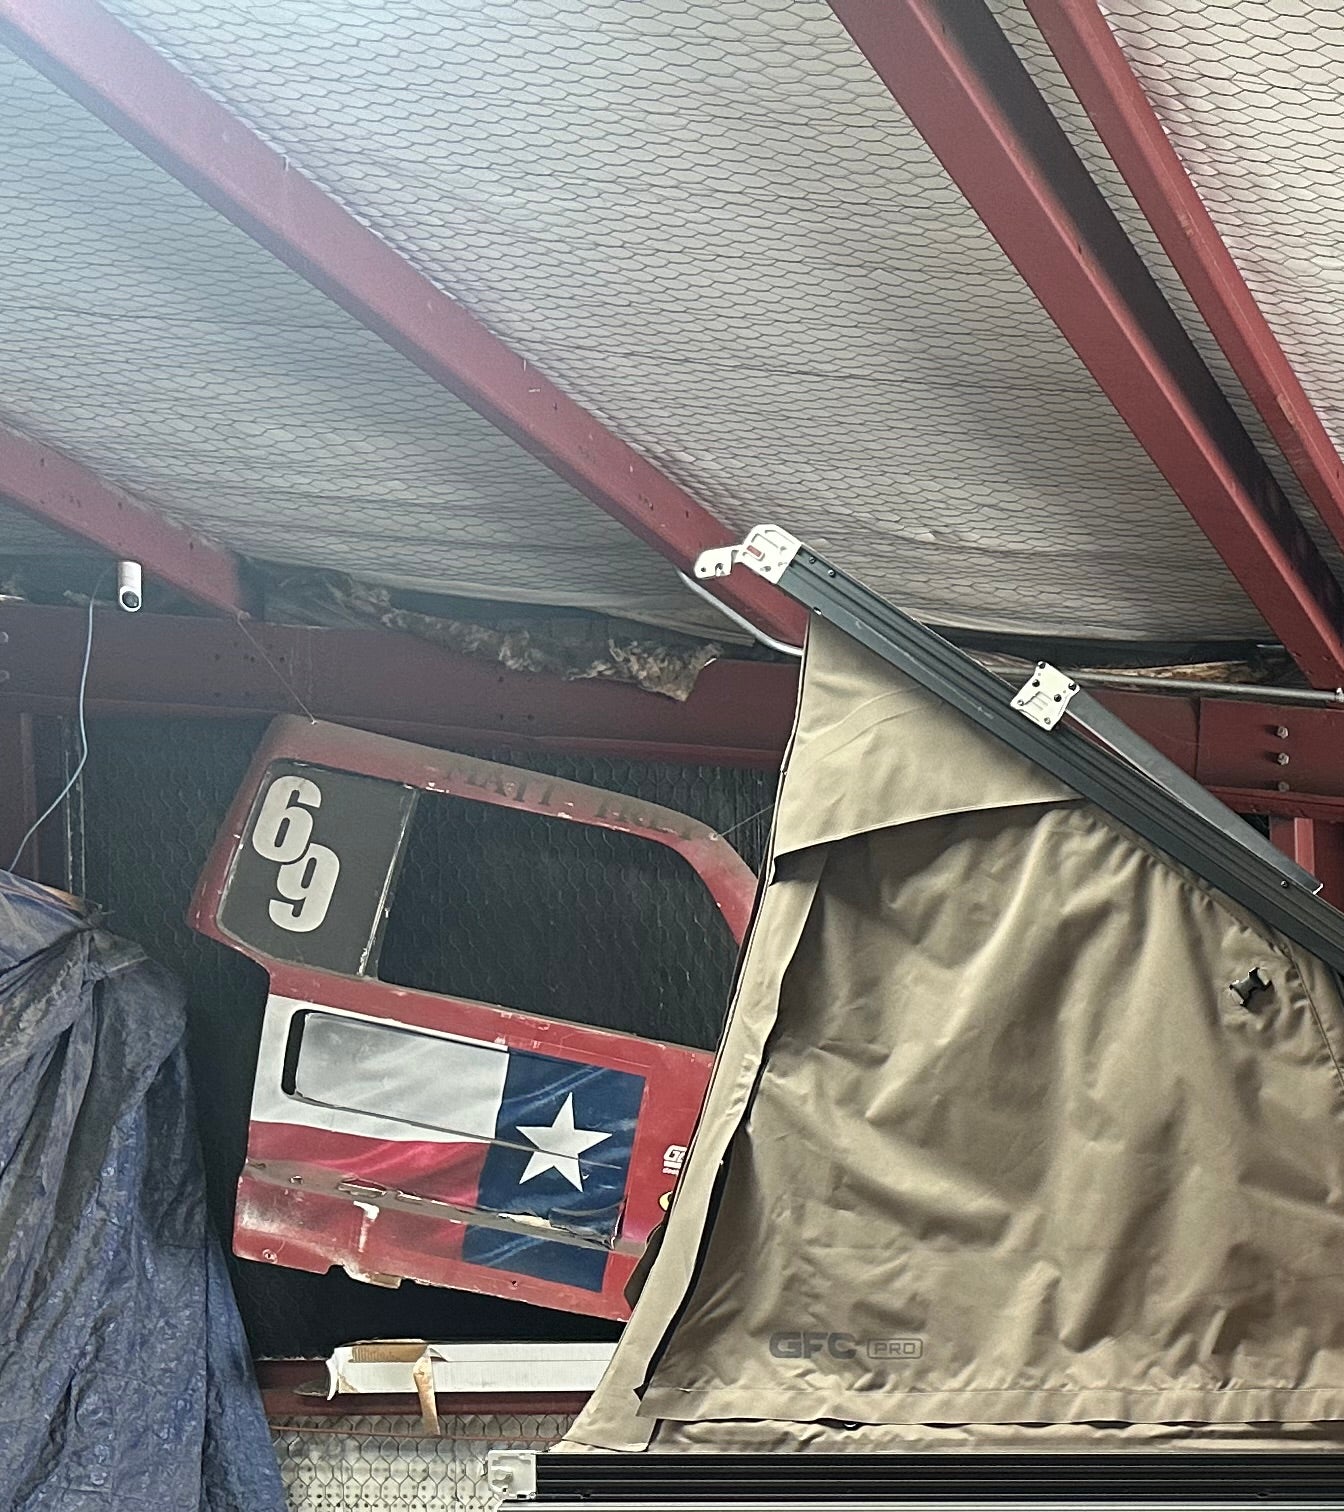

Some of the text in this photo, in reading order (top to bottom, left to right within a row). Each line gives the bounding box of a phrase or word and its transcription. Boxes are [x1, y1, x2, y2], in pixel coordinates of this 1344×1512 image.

[252, 775, 340, 932] 69
[769, 1332, 916, 1359] GFC PRO
